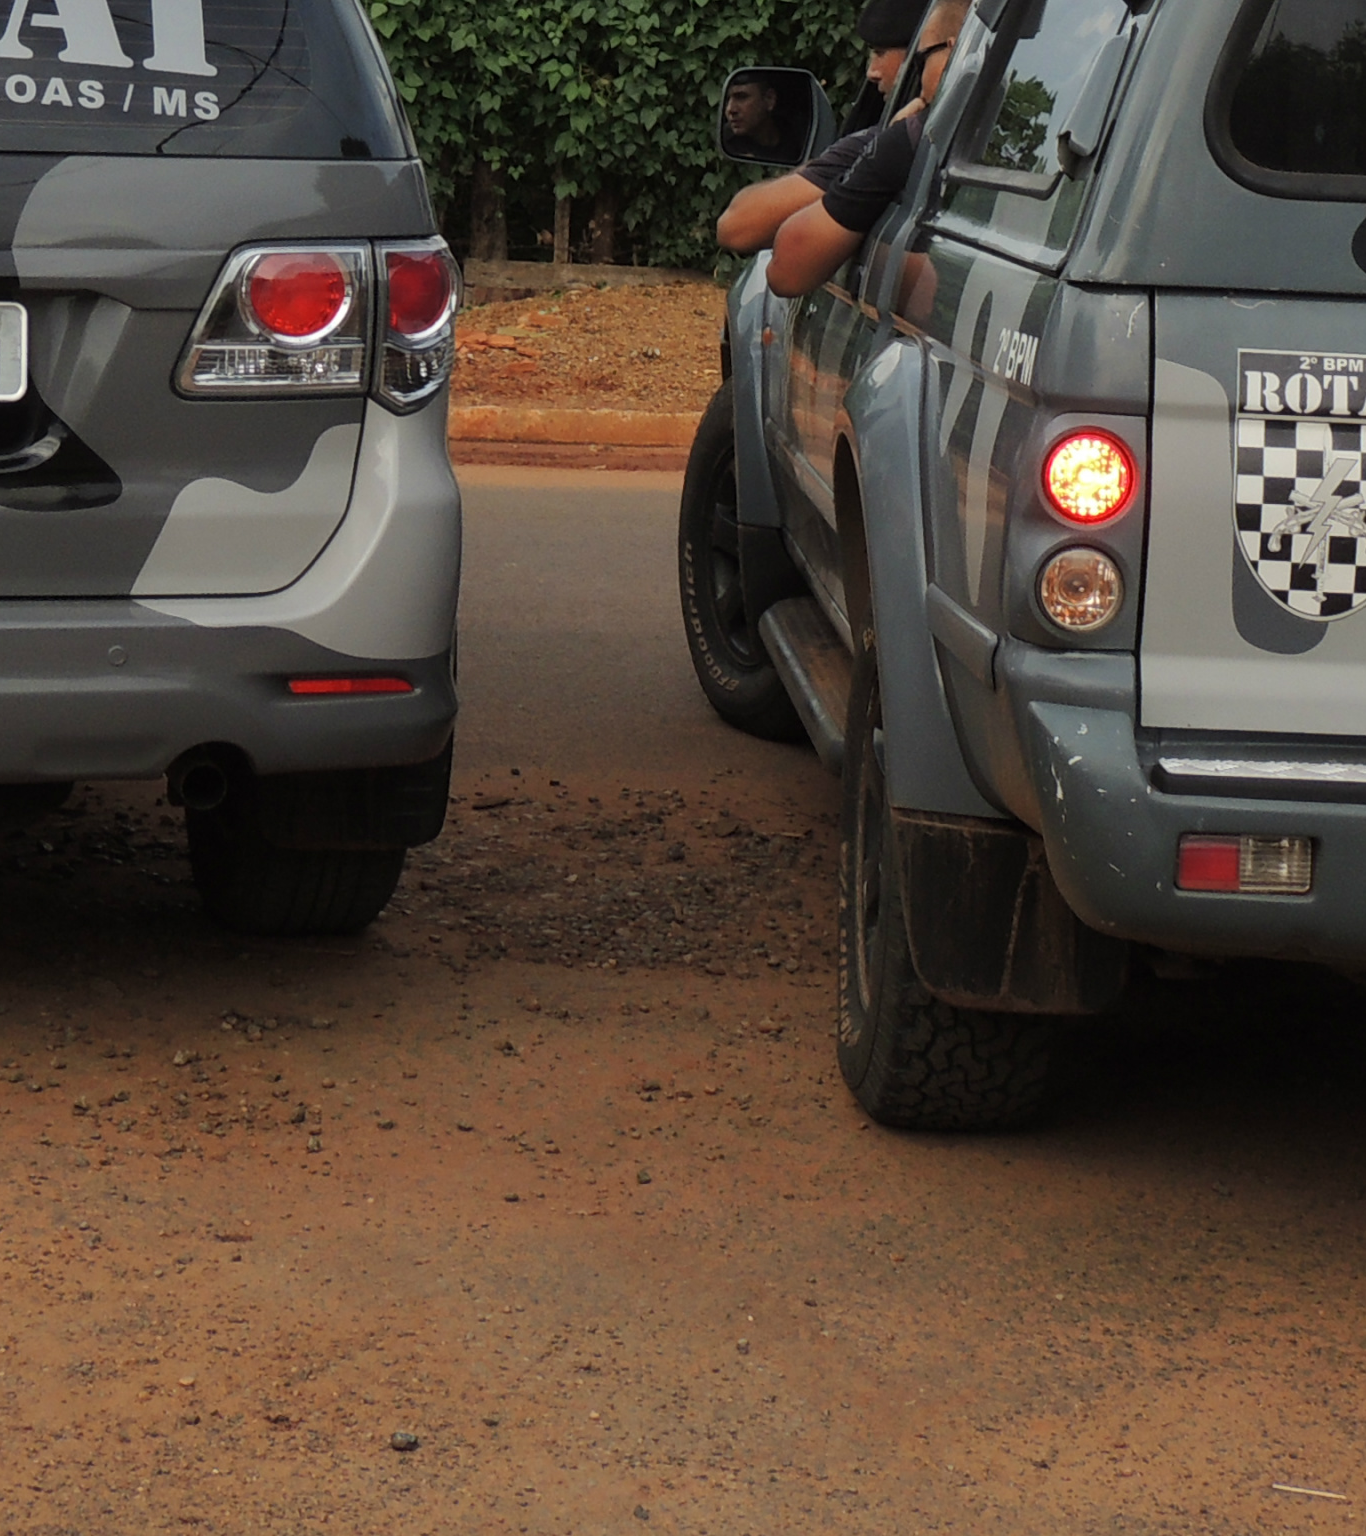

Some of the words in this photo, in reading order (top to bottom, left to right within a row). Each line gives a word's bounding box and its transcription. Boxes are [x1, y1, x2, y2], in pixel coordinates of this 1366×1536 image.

[152, 86, 221, 122] MS
[1005, 330, 1039, 387] BPM
[1323, 357, 1364, 373] BPM
